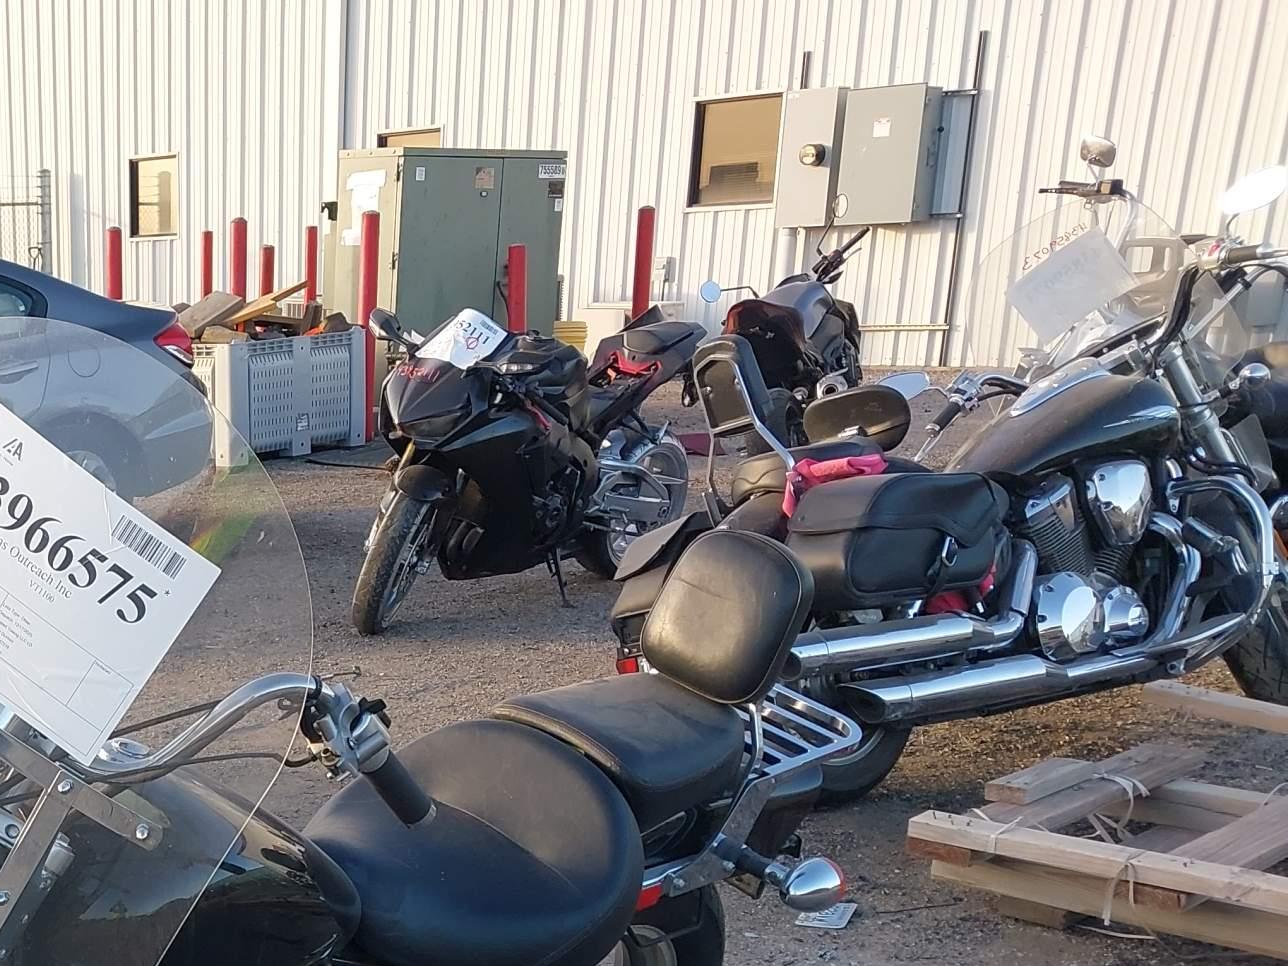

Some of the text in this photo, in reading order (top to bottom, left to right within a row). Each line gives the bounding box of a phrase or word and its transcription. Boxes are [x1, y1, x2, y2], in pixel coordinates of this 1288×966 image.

[9, 545, 54, 585] Outreach
[55, 579, 72, 599] Inc
[29, 579, 55, 602] VT1100
